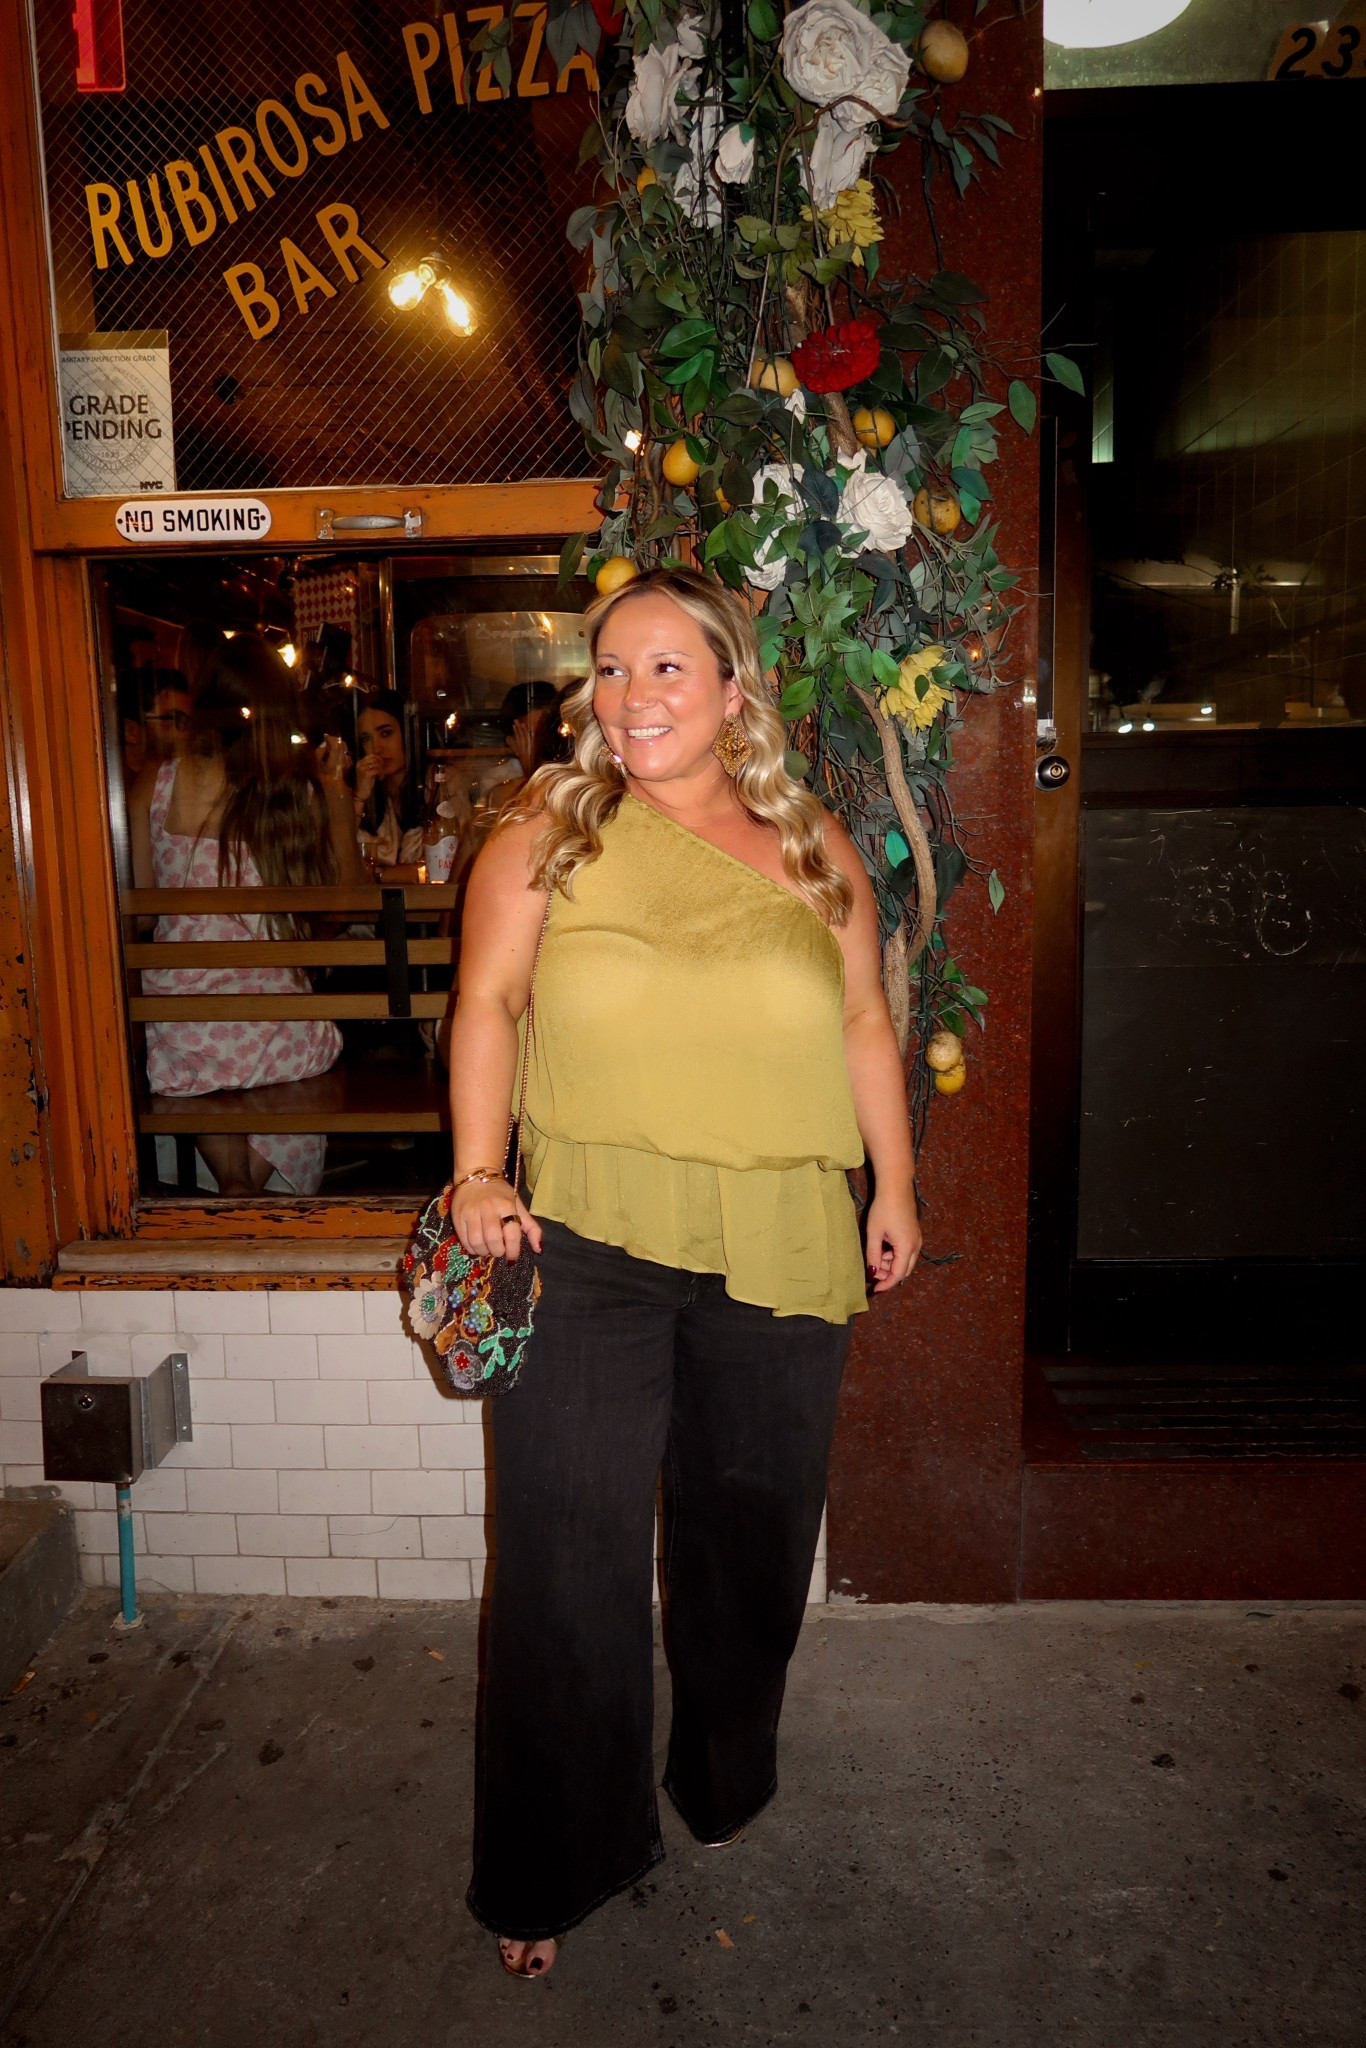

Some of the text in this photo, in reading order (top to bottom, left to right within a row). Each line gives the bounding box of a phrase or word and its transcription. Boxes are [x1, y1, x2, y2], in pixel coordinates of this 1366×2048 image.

[1274, 25, 1366, 80] 23
[84, 2, 600, 270] RUBIROSA PIZZA
[222, 202, 388, 340] BAR
[61, 354, 156, 363] ANITARY INSPECTION GRADE
[69, 394, 148, 415] GRADE
[140, 480, 163, 490] NYC
[125, 507, 261, 533] NO SMOKING
